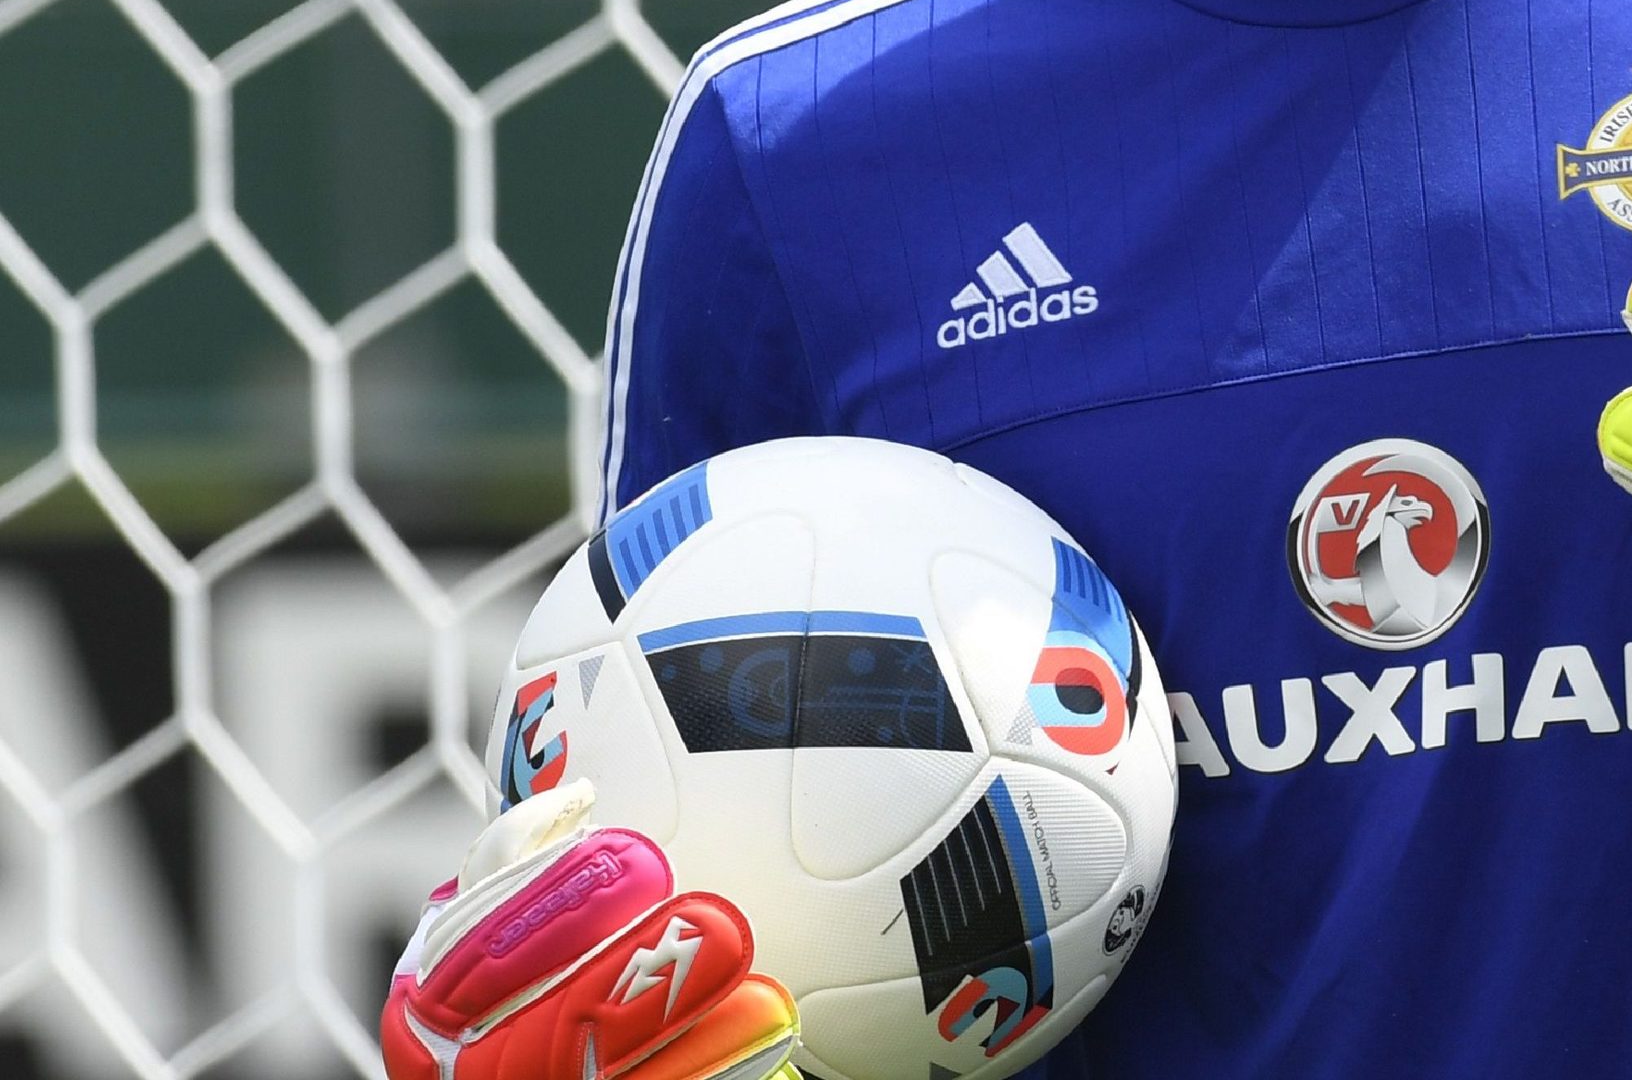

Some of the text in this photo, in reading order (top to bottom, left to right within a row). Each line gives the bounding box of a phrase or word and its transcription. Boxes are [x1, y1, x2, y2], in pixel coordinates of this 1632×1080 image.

[936, 285, 1099, 349] adidas
[1022, 791, 1062, 911] OFFICIAL MATCH BALL
